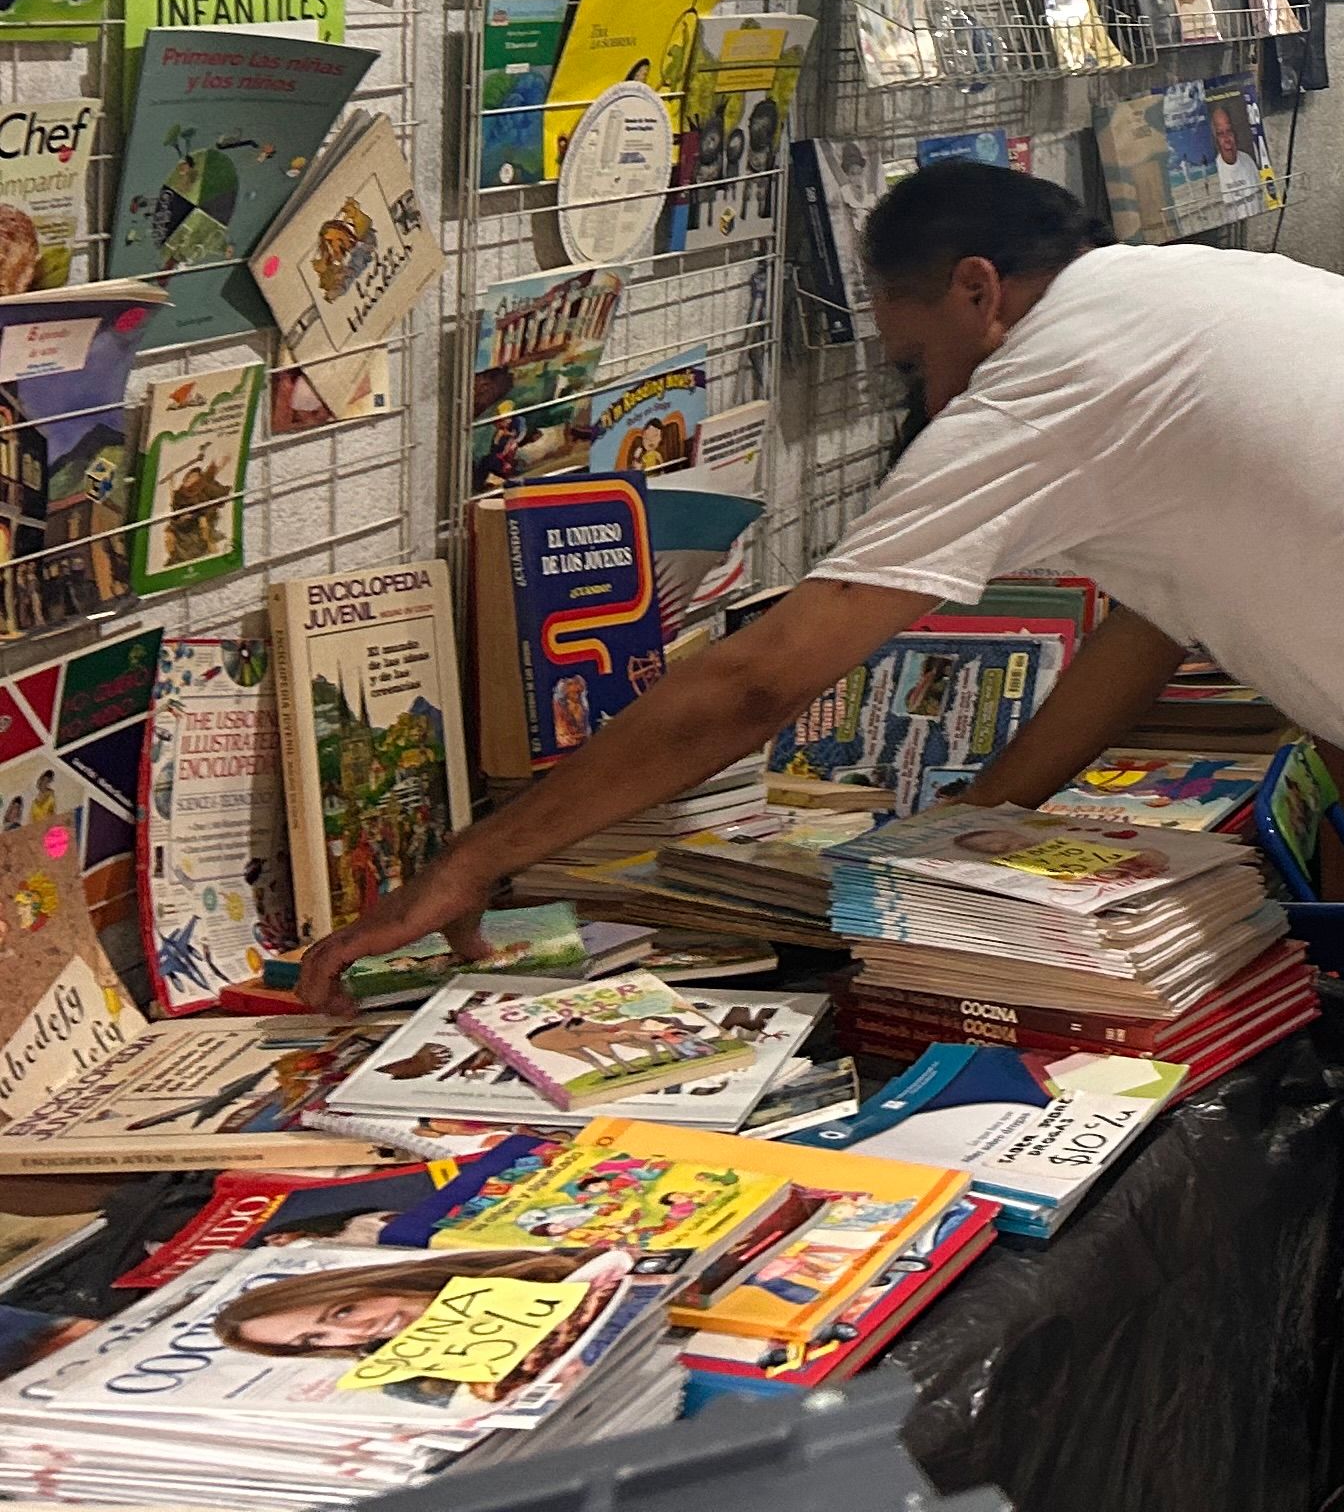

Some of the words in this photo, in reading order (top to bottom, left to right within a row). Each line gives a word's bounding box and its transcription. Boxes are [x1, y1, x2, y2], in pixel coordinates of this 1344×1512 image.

[162, 47, 244, 68] Primero
[250, 53, 284, 70] las
[288, 53, 347, 77] niñas
[202, 72, 236, 90] los
[240, 74, 297, 92] niños
[0, 106, 91, 160] Chef
[545, 527, 564, 549] EL
[565, 522, 623, 547] UNIVERSO
[542, 554, 560, 576] DE
[560, 552, 582, 574] LOS
[583, 545, 633, 571] JÓVENES
[307, 570, 433, 606] ENCICLOPEDIA
[304, 601, 378, 631] JUVENIL
[185, 711, 211, 732] THE
[214, 709, 279, 731] USBORN
[178, 754, 279, 781] ENCYCLOPEDI
[960, 999, 1019, 1025] COCINA
[962, 1018, 1018, 1044] COCINA
[1029, 1117, 1075, 1157] DROGAS
[1047, 1132, 1108, 1167] $10
[354, 1287, 493, 1380] COCINA
